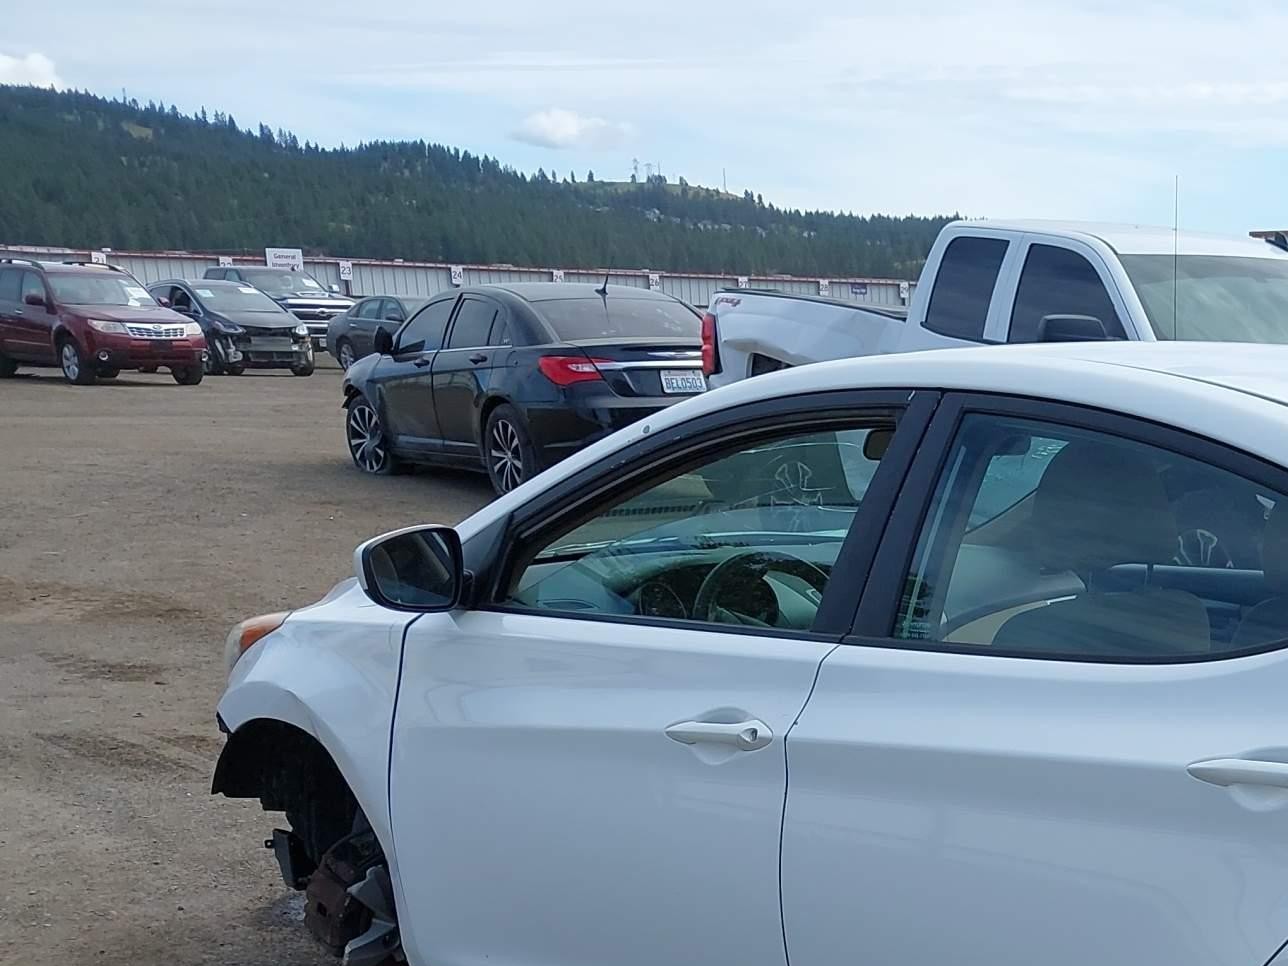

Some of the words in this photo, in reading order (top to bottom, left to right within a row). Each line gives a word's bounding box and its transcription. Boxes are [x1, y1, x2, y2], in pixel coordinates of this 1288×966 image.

[341, 266, 352, 275] 23
[452, 271, 463, 280] 24
[650, 278, 660, 287] 26
